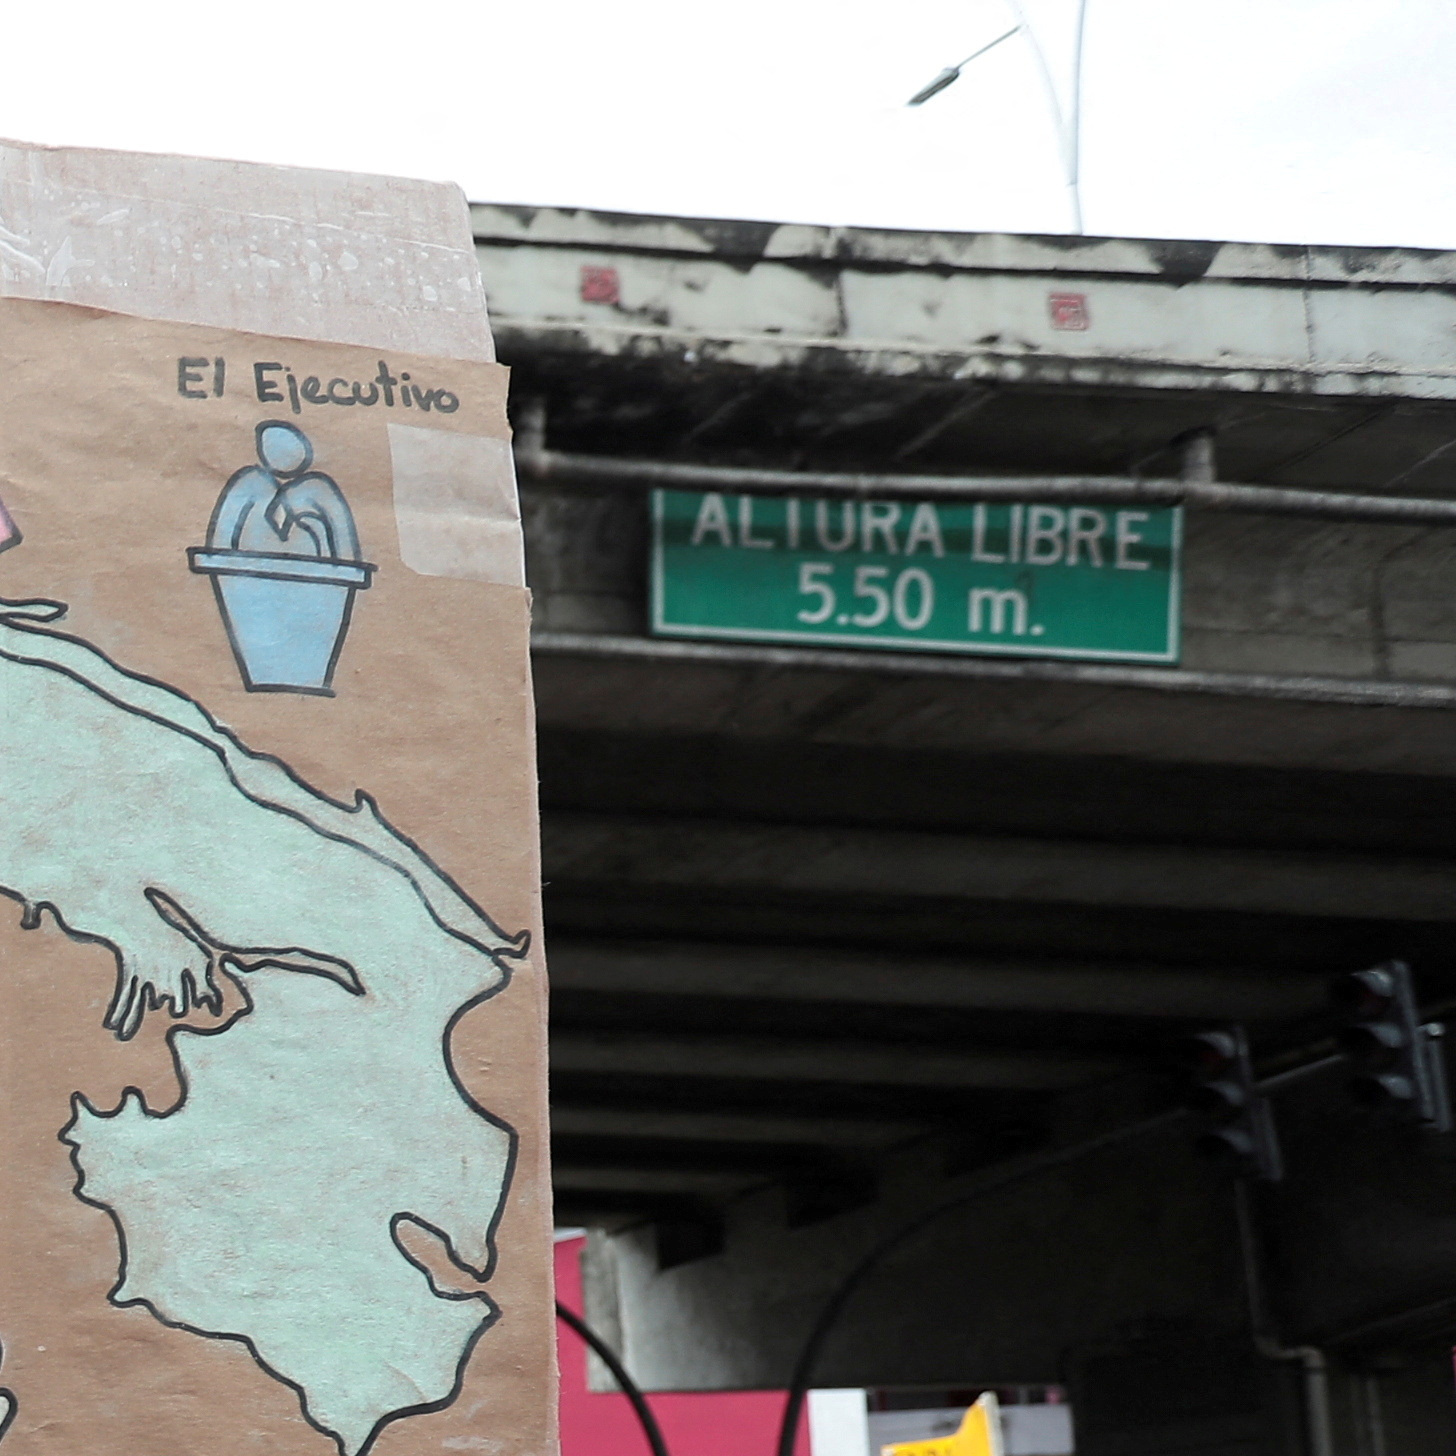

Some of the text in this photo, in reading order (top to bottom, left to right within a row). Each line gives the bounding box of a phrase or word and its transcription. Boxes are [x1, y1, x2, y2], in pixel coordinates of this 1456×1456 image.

[178, 356, 461, 414] El Ejecutivo
[690, 492, 1152, 572] ALTURA LIBRE
[797, 563, 935, 633] 5.50
